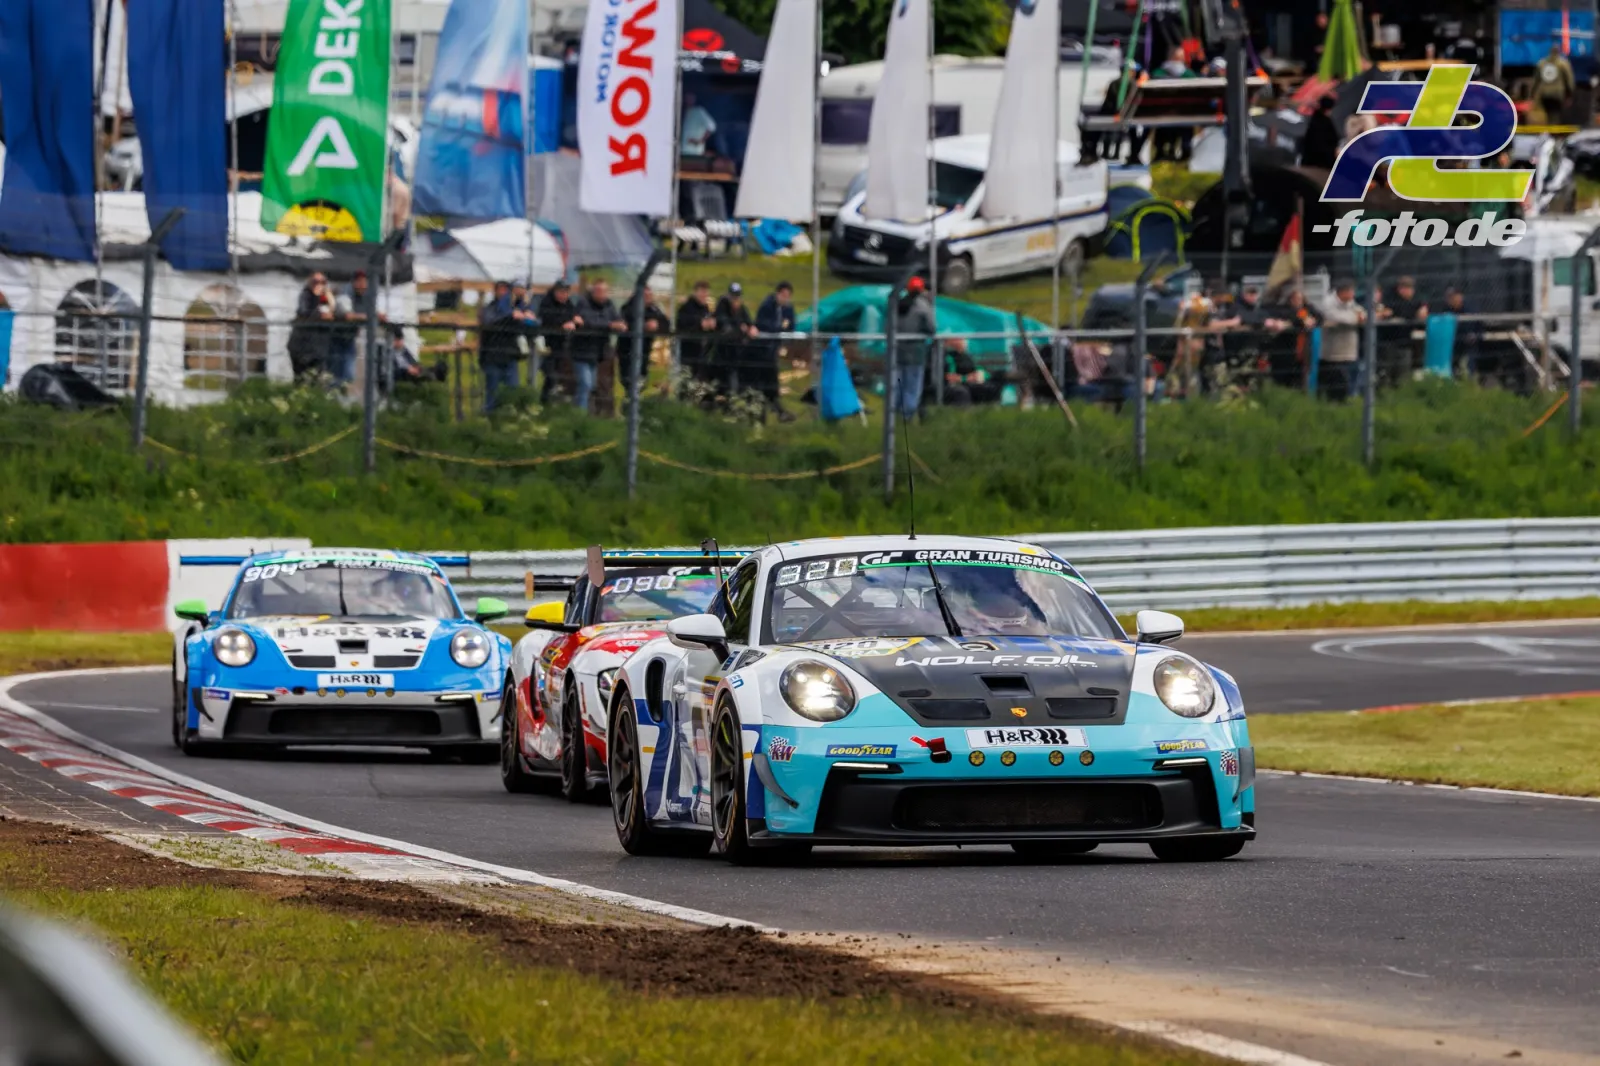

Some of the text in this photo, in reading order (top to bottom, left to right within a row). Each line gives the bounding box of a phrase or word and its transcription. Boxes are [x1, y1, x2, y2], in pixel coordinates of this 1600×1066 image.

[308, 0, 363, 95] DEK
[914, 550, 1064, 572] GRAN TURISMO
[243, 562, 299, 583] 904
[612, 574, 677, 594] 090
[894, 653, 1023, 667] WOLF
[1025, 653, 1097, 665] OIL
[329, 674, 361, 685] H&R
[984, 728, 1037, 745] H&R
[771, 744, 797, 762] KW
